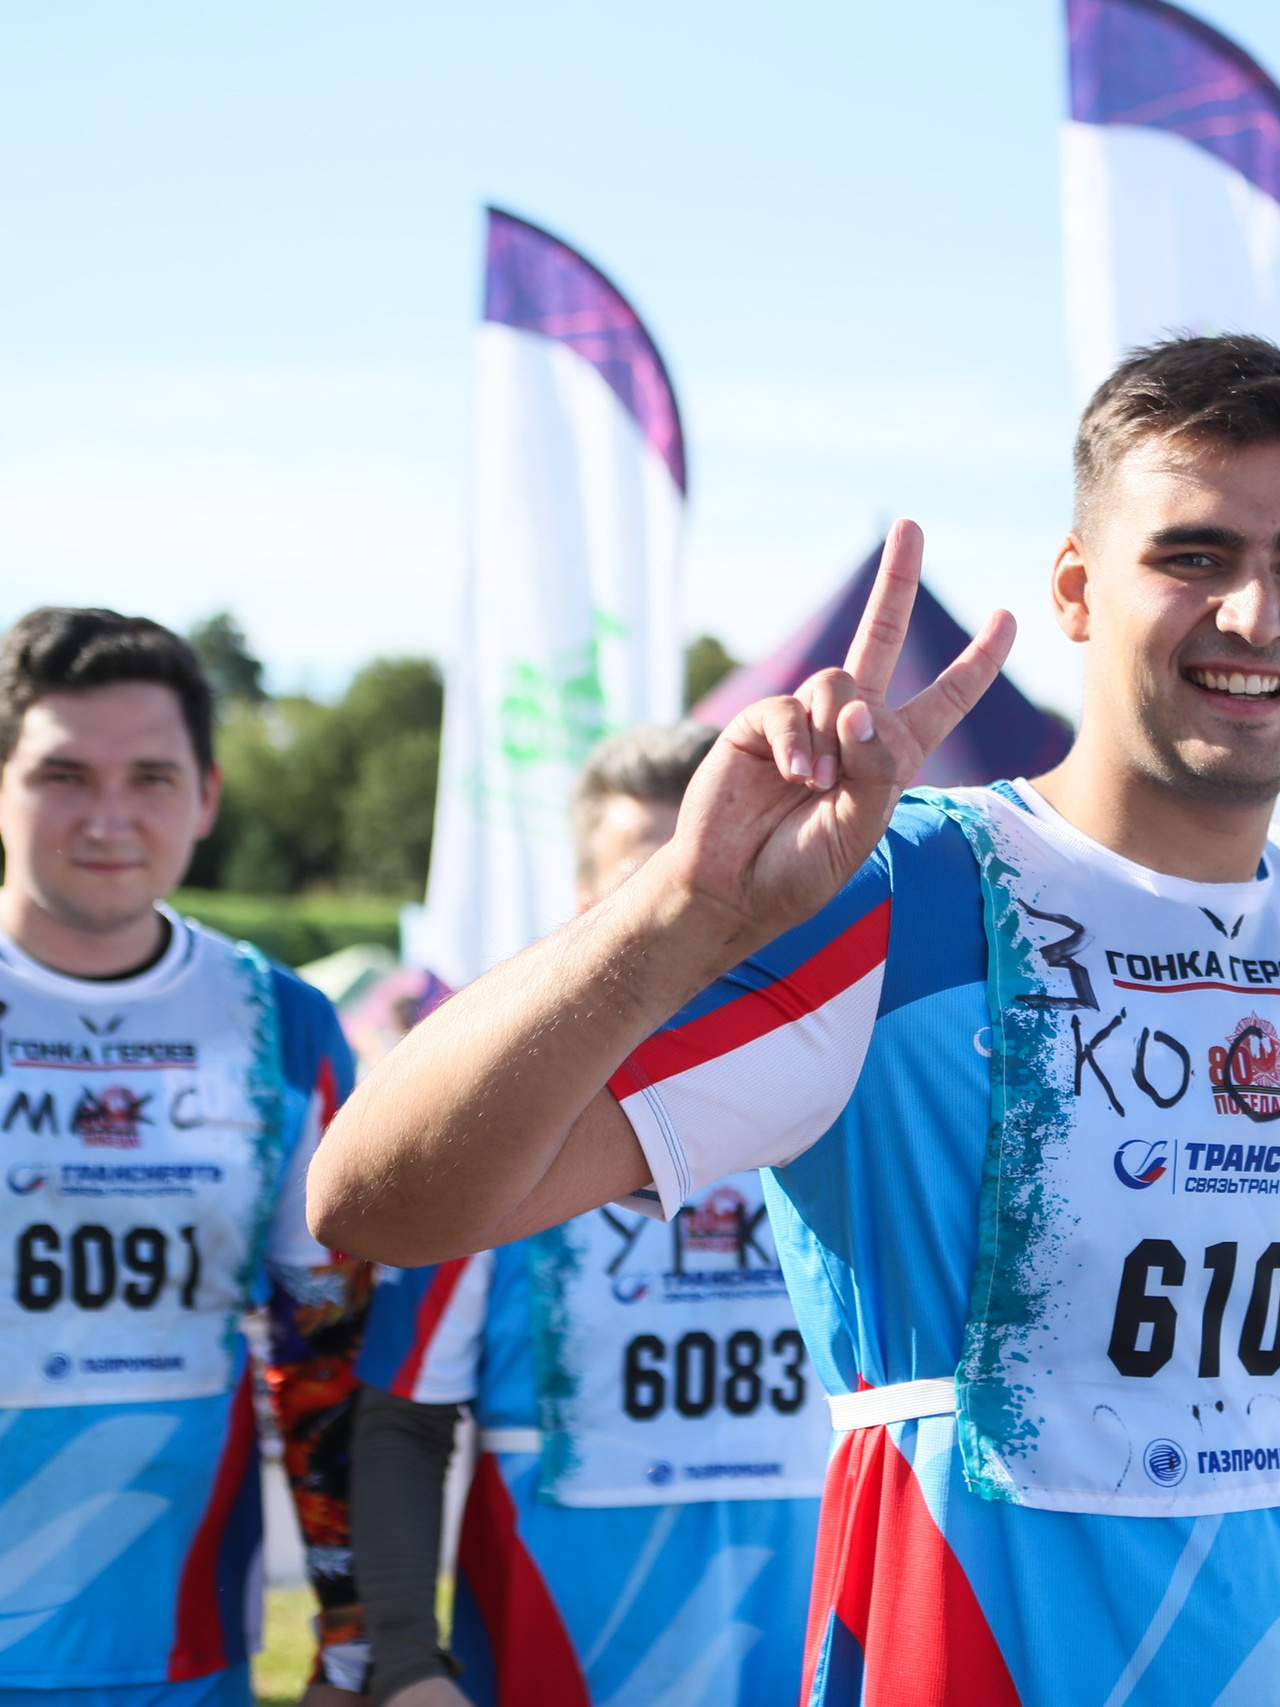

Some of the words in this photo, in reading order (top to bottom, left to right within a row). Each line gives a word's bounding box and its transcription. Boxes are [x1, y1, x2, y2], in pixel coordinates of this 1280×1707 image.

[1105, 949, 1226, 982] ГОНКА
[1208, 1045, 1255, 1086] 80
[16, 1222, 201, 1313] 6091
[623, 1329, 806, 1422] 6083
